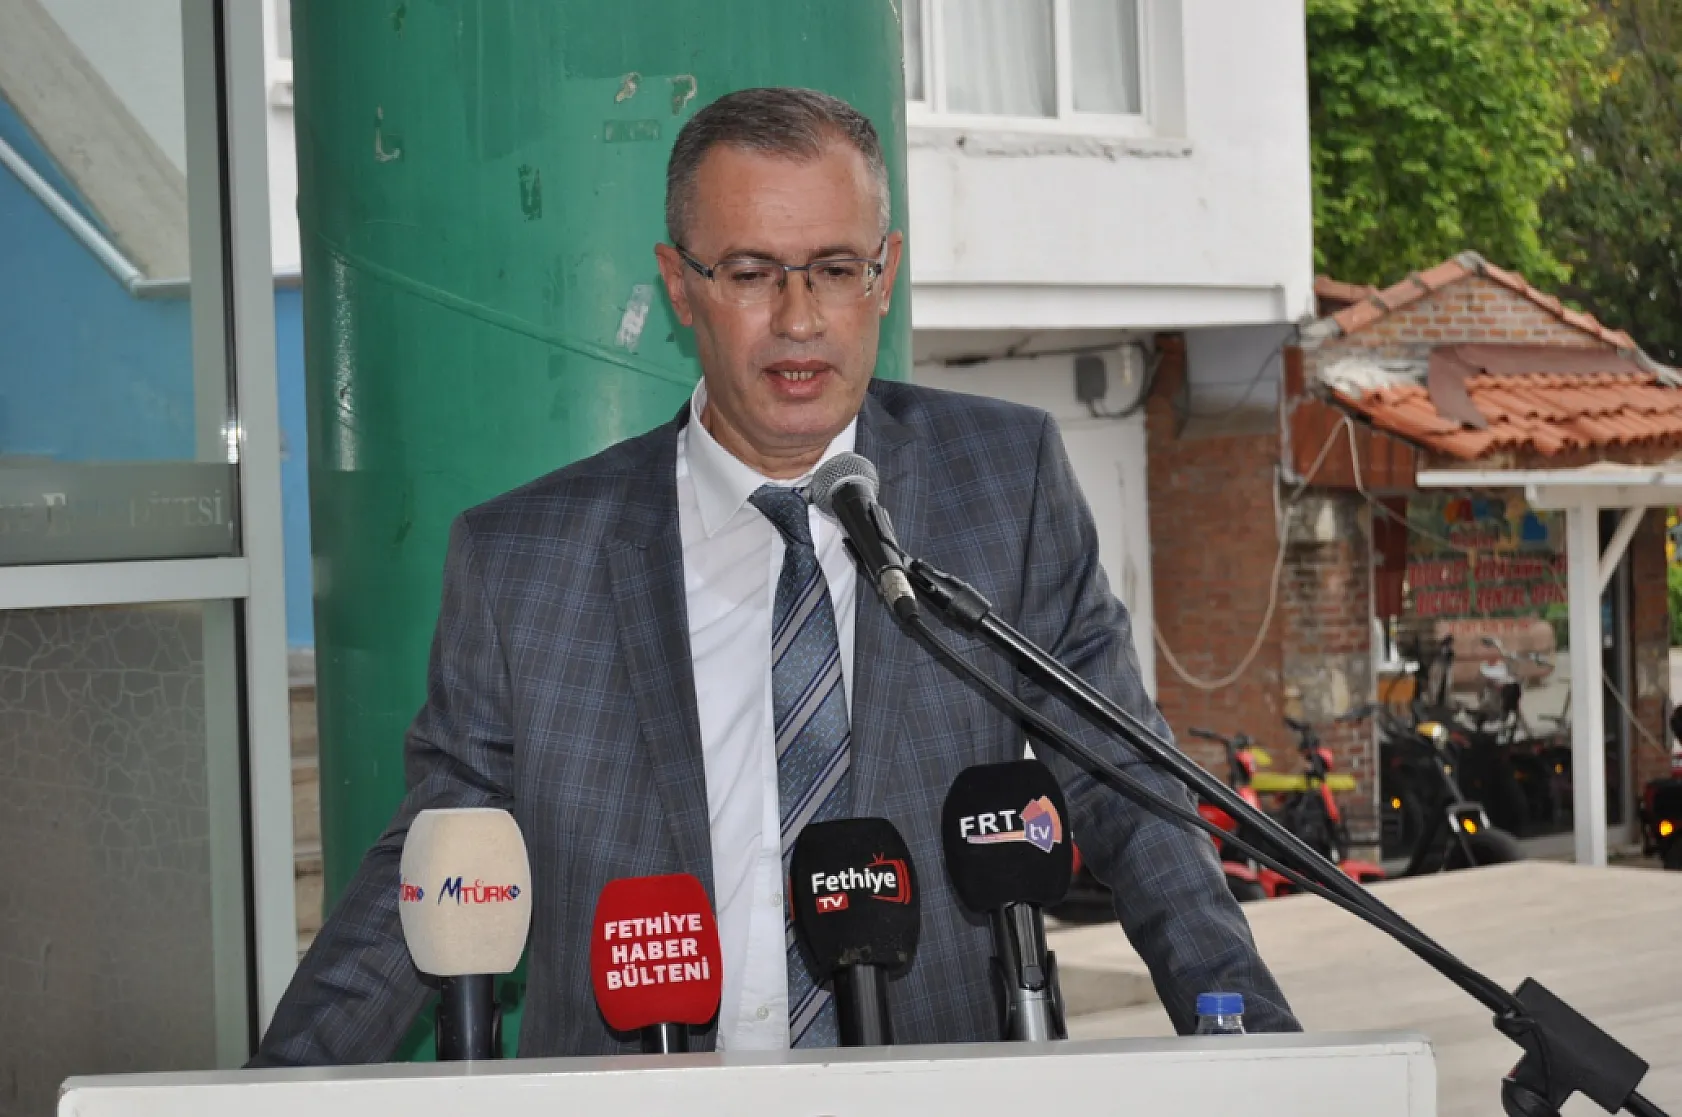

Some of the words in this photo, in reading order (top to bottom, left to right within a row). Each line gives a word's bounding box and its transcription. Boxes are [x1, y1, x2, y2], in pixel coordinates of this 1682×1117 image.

[960, 808, 1016, 839] FRT
[1029, 823, 1050, 841] tv
[811, 867, 896, 894] Fethiye
[818, 895, 843, 909] TV
[604, 911, 703, 940] FETHİYE
[612, 937, 699, 964] HABER
[606, 956, 710, 990] BÜLTENİ
